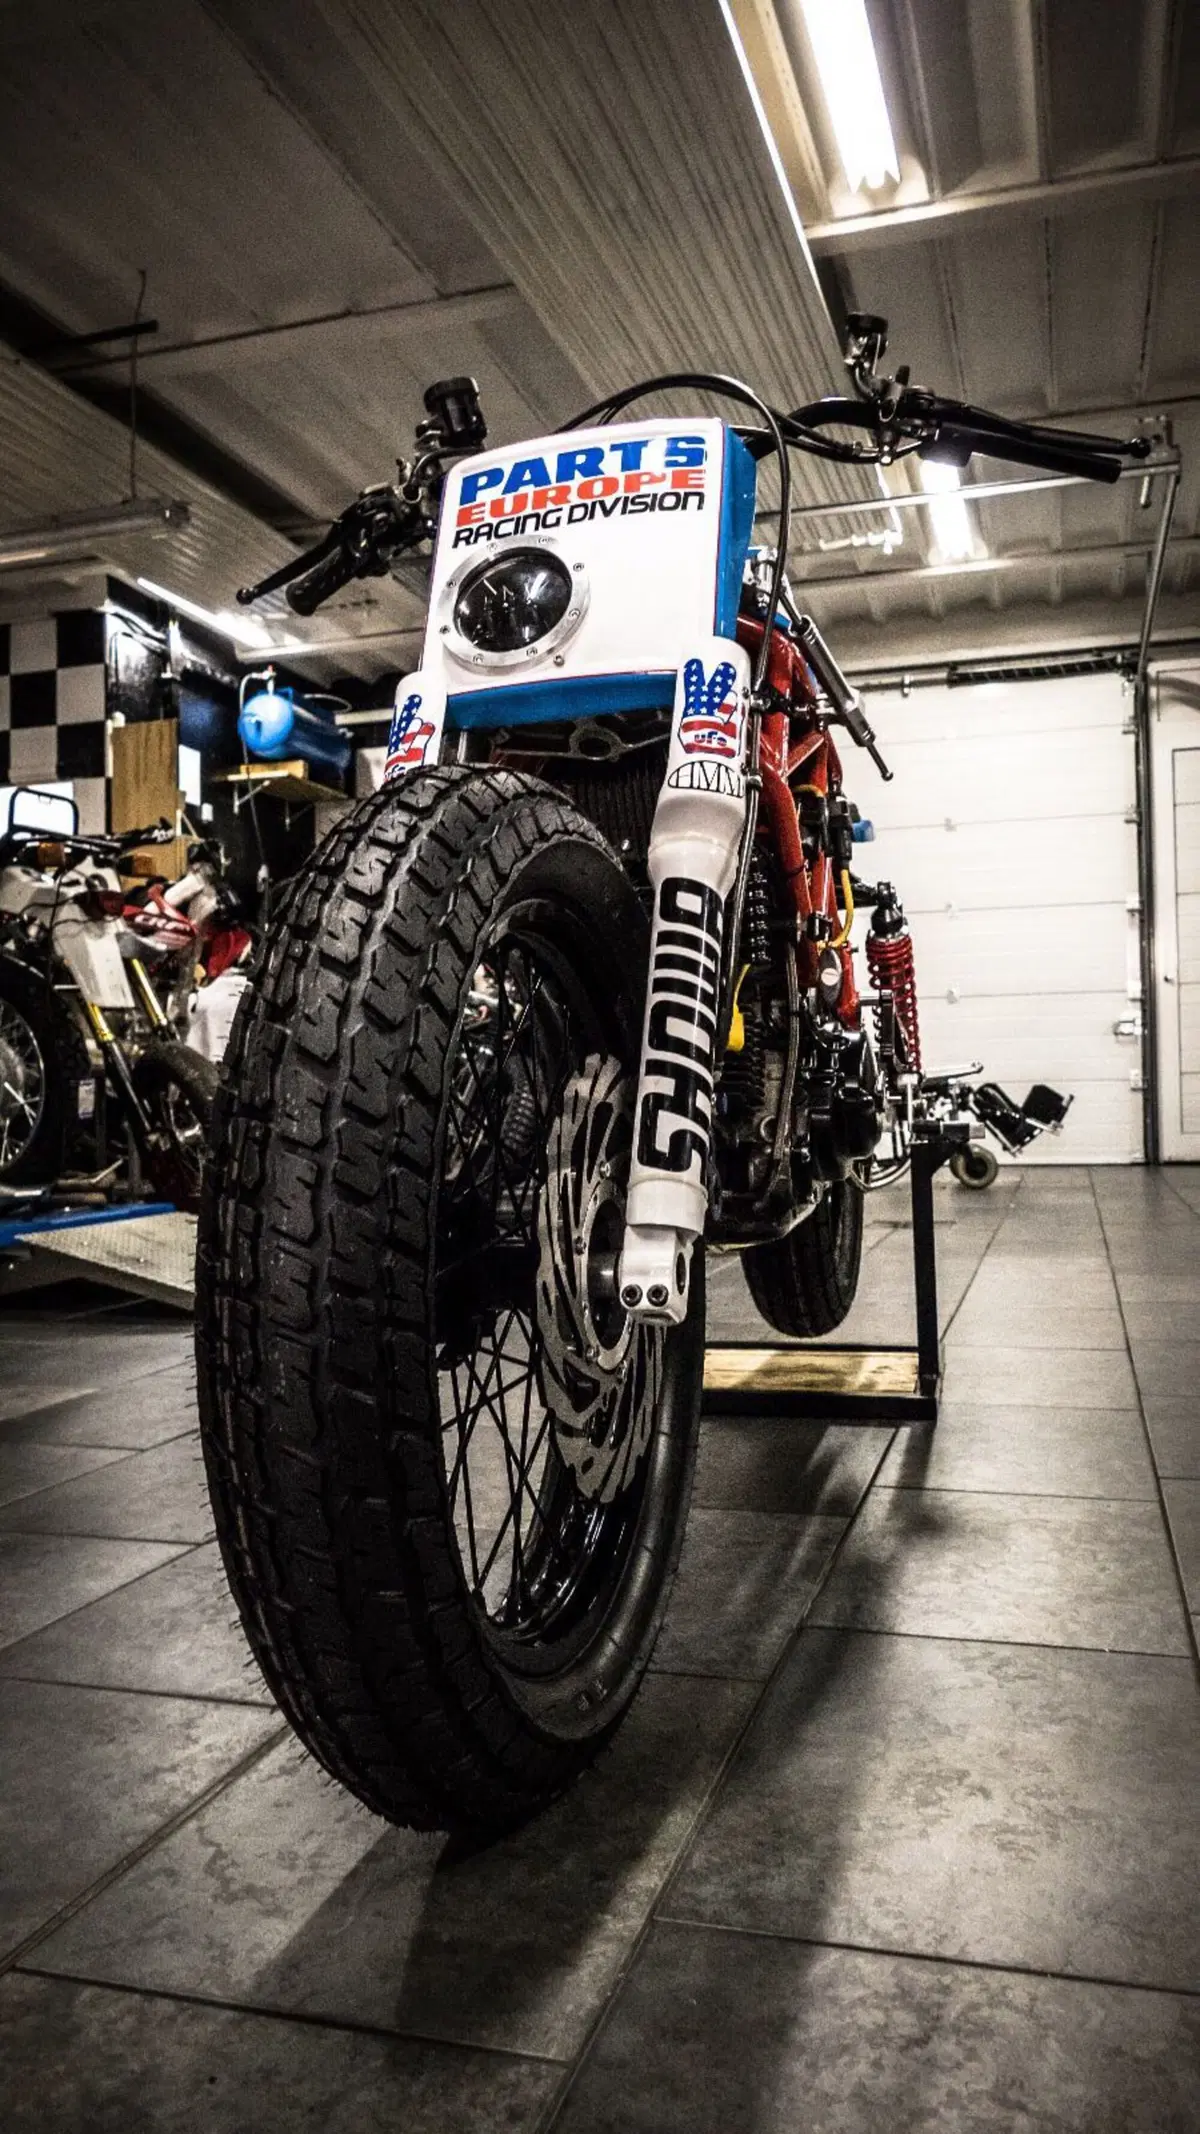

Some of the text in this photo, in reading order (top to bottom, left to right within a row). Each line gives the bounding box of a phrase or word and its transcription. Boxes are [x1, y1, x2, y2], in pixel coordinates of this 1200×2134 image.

[456, 469, 706, 528] EUROPE
[459, 436, 707, 506] PARTS
[451, 490, 705, 549] RACING DIVISION
[637, 876, 725, 1185] SHOWA
